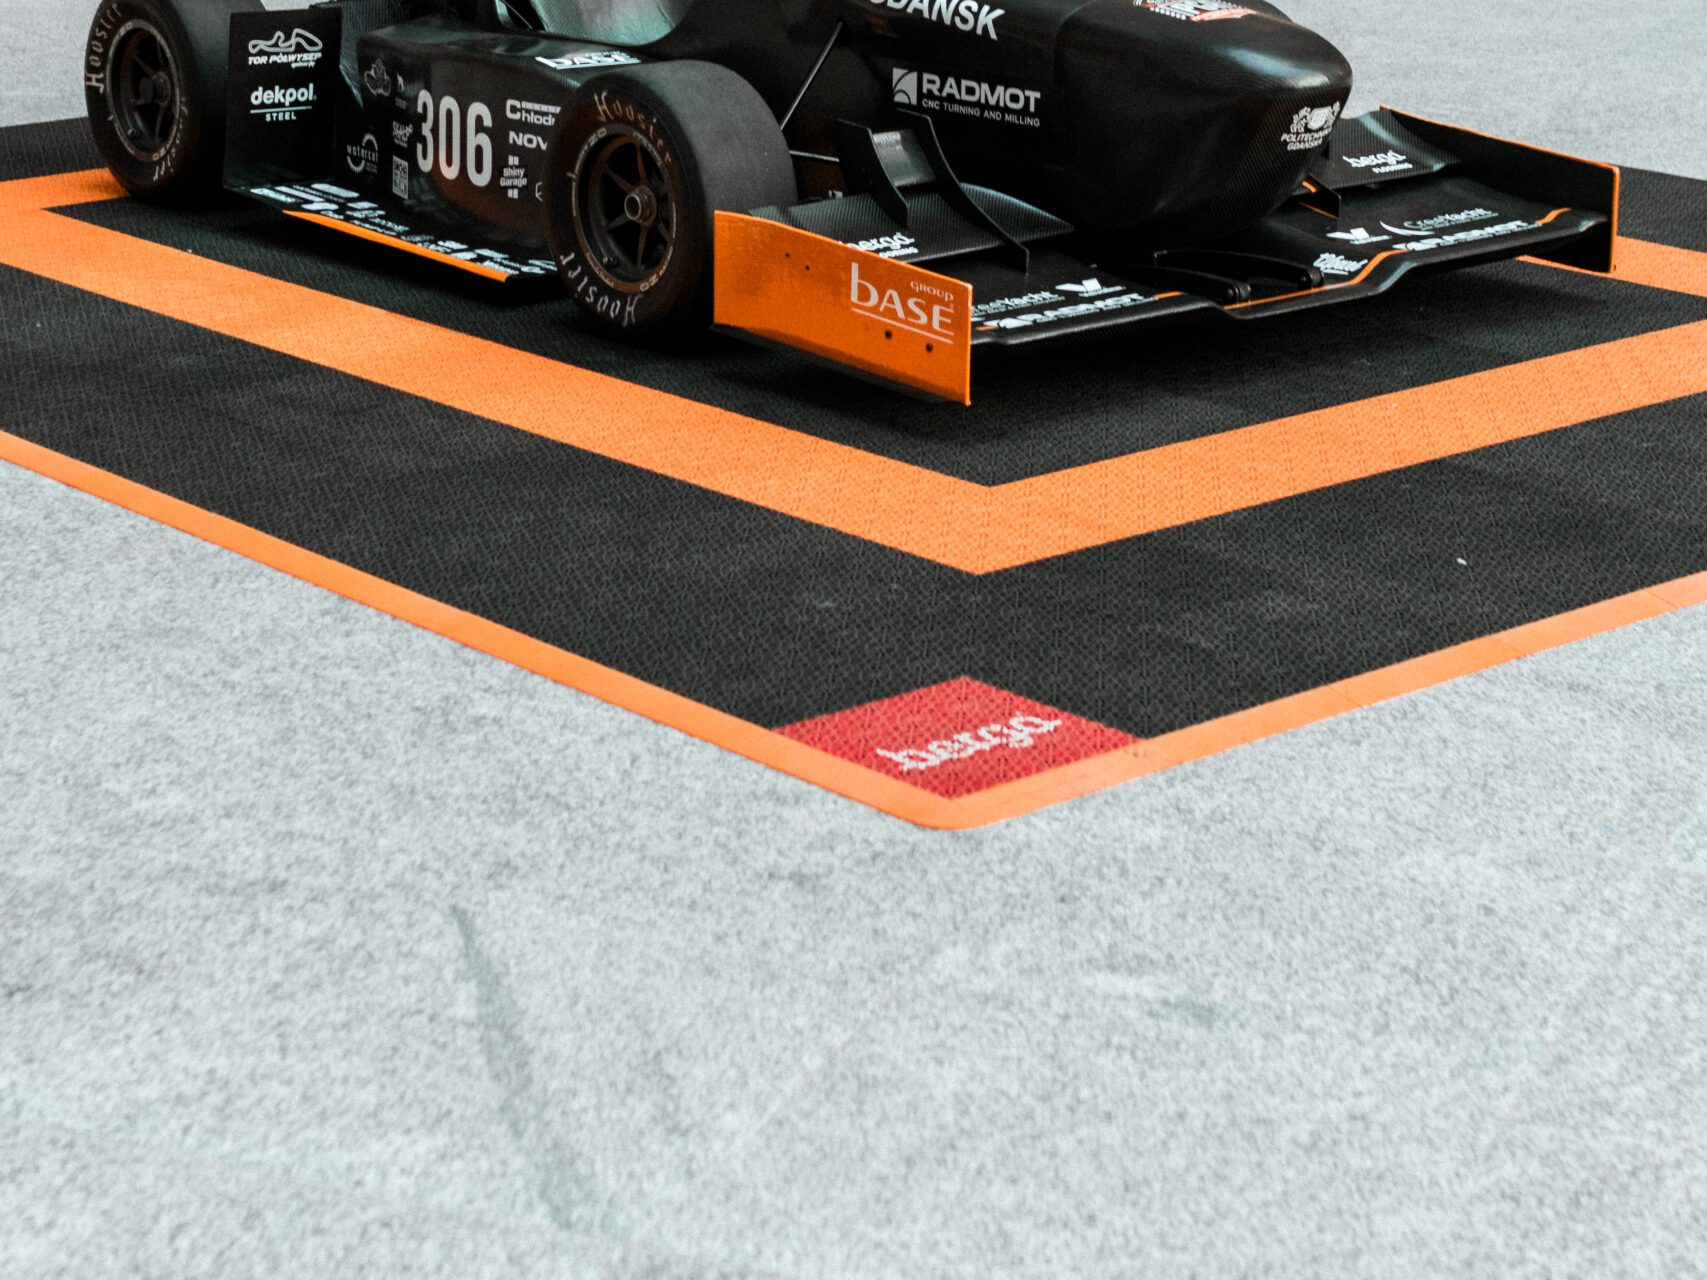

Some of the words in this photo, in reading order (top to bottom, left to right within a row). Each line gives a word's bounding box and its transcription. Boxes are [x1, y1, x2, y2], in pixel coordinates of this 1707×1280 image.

[248, 55, 268, 66] TOR
[250, 83, 314, 107] dekpol
[922, 72, 1041, 113] RADMOT
[265, 111, 297, 122] STEEL
[922, 98, 941, 110] CNC
[943, 102, 981, 117] TURNING
[983, 109, 1002, 121] AND
[1005, 113, 1041, 128] MILLING
[416, 89, 493, 188] 306
[1342, 149, 1407, 168] bergo
[500, 177, 527, 188] Garage
[503, 167, 525, 179] Shiny
[876, 711, 1063, 771] bergo
